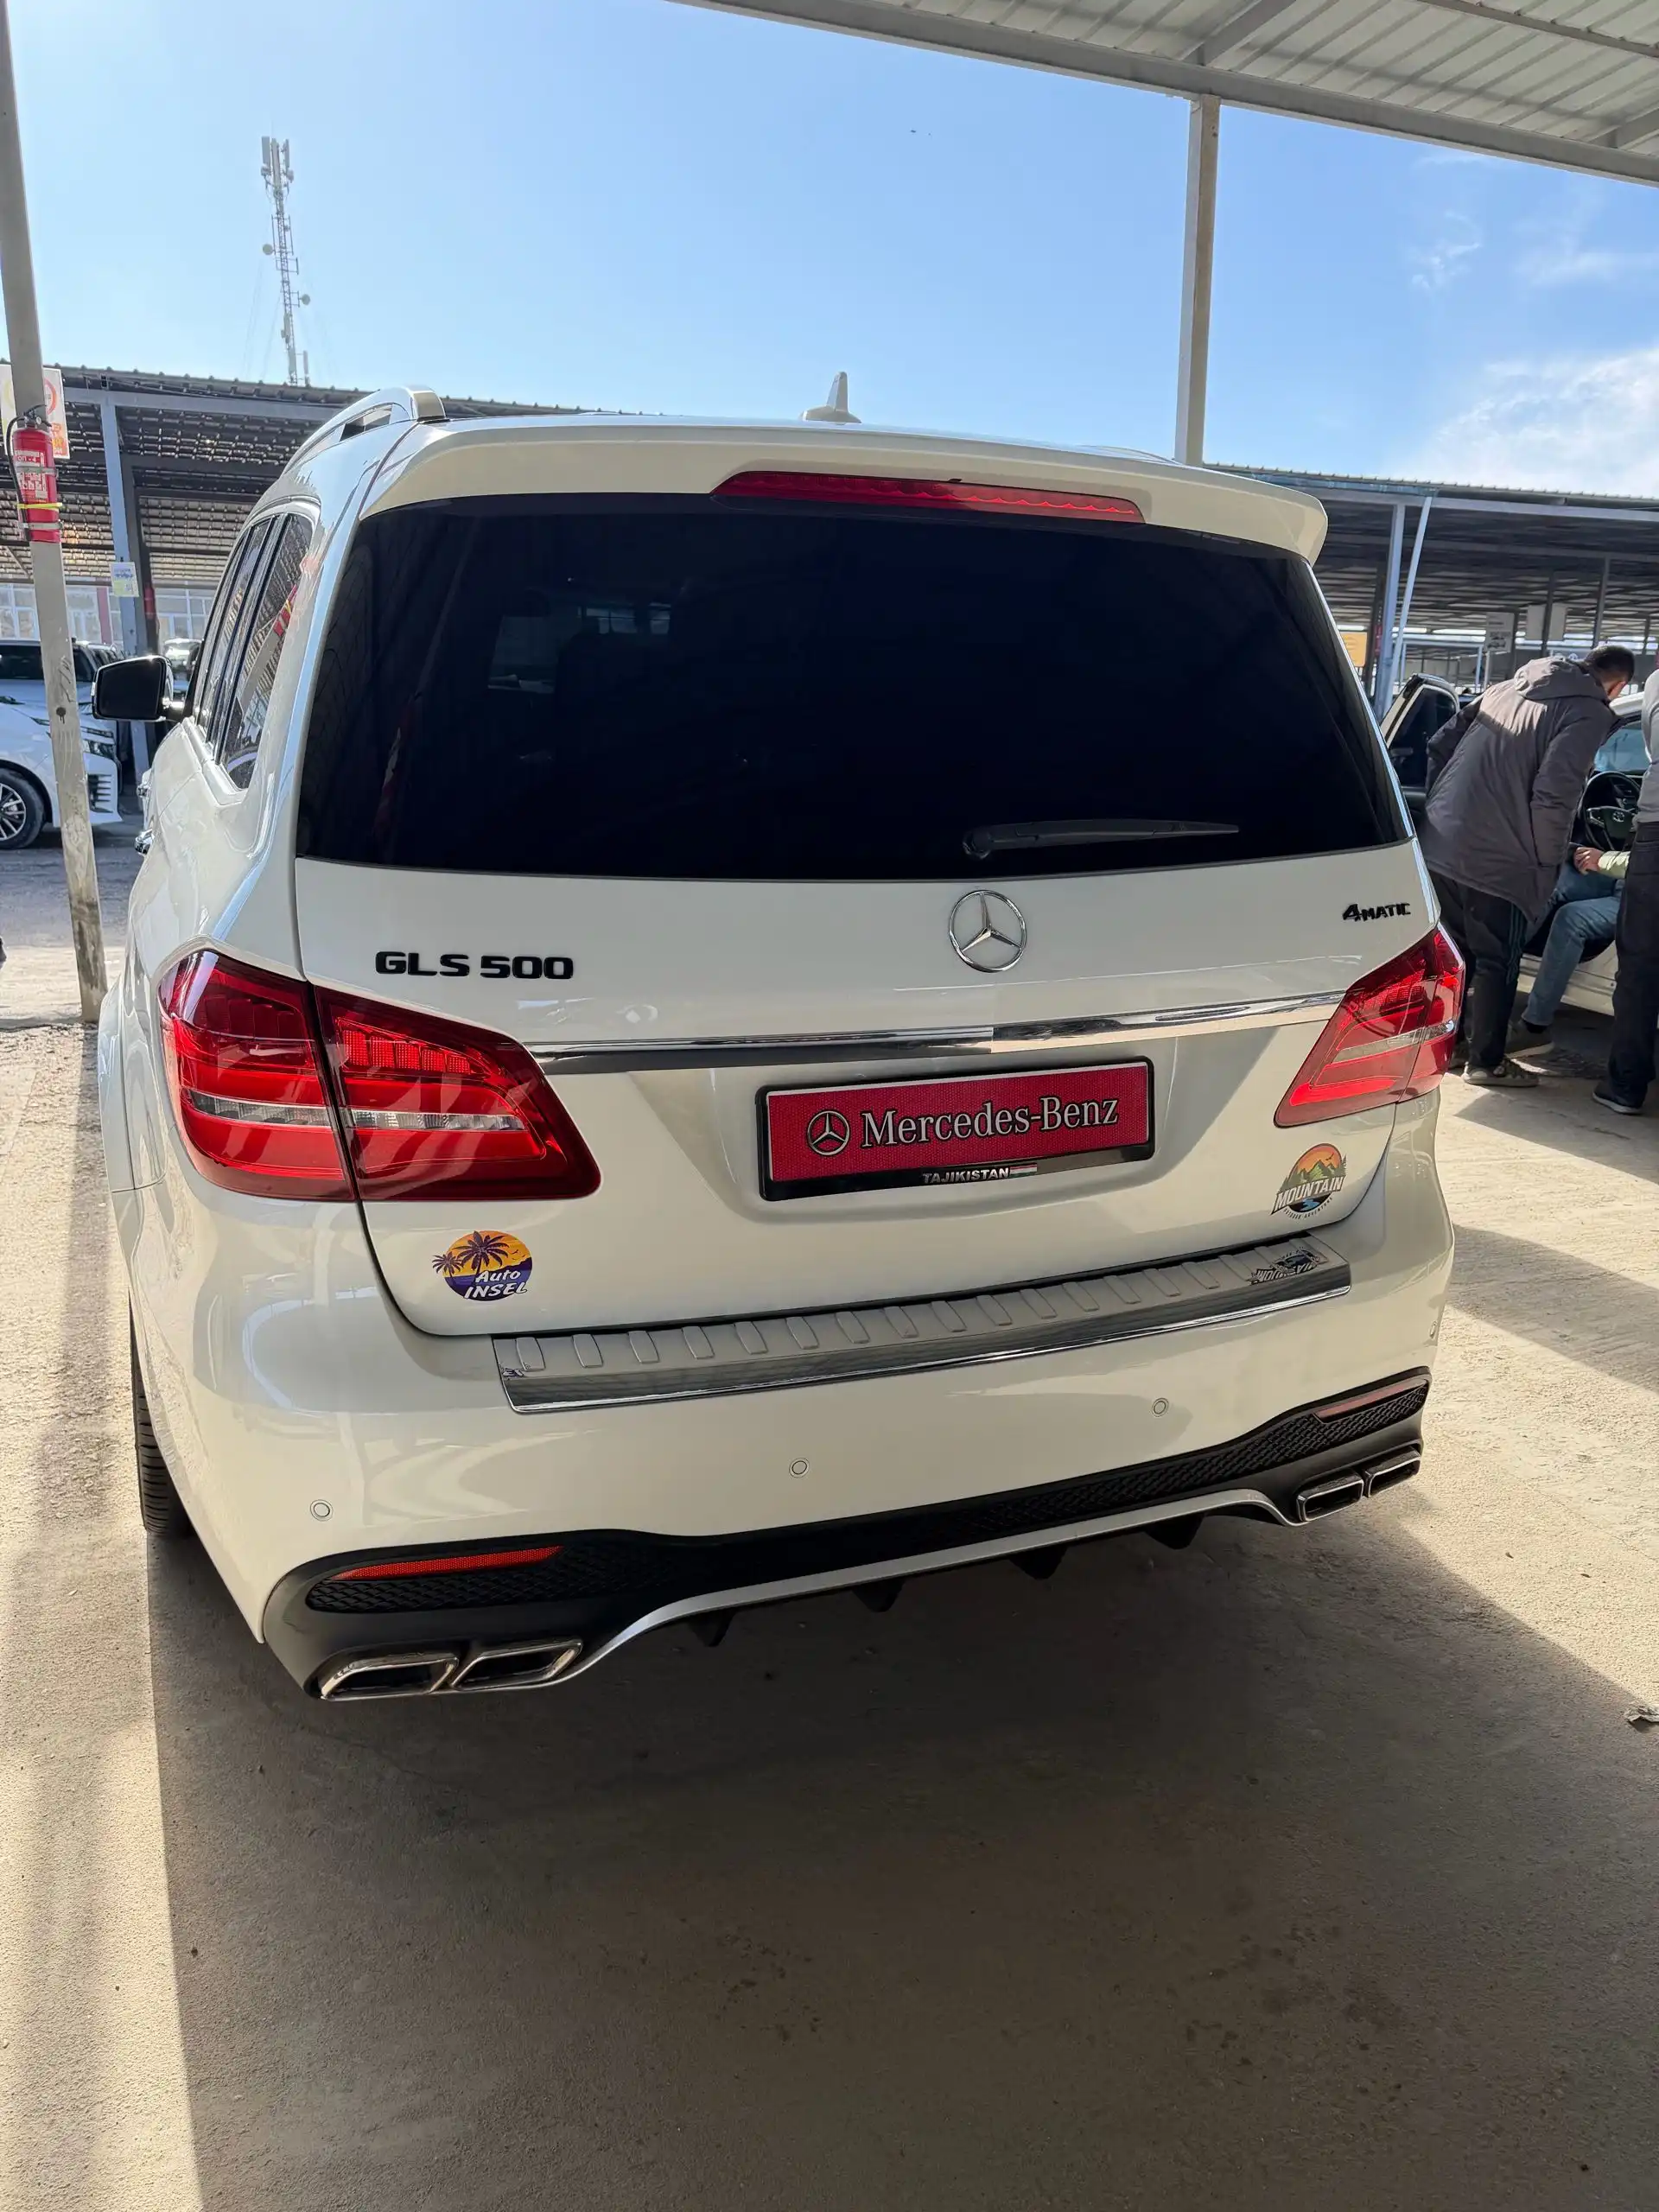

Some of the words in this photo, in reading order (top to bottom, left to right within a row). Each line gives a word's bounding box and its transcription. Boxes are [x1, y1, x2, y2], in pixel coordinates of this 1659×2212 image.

[1342, 903, 1411, 922] 4MATIC
[375, 950, 470, 977] GLS
[480, 955, 574, 980] 500
[861, 1095, 1119, 1147] Mercedes-Benz
[922, 1166, 1010, 1185] TAJIKISTAN
[1274, 1175, 1344, 1211] MOUNTAIN
[475, 1268, 521, 1283] Auto
[464, 1281, 528, 1299] INSEL
